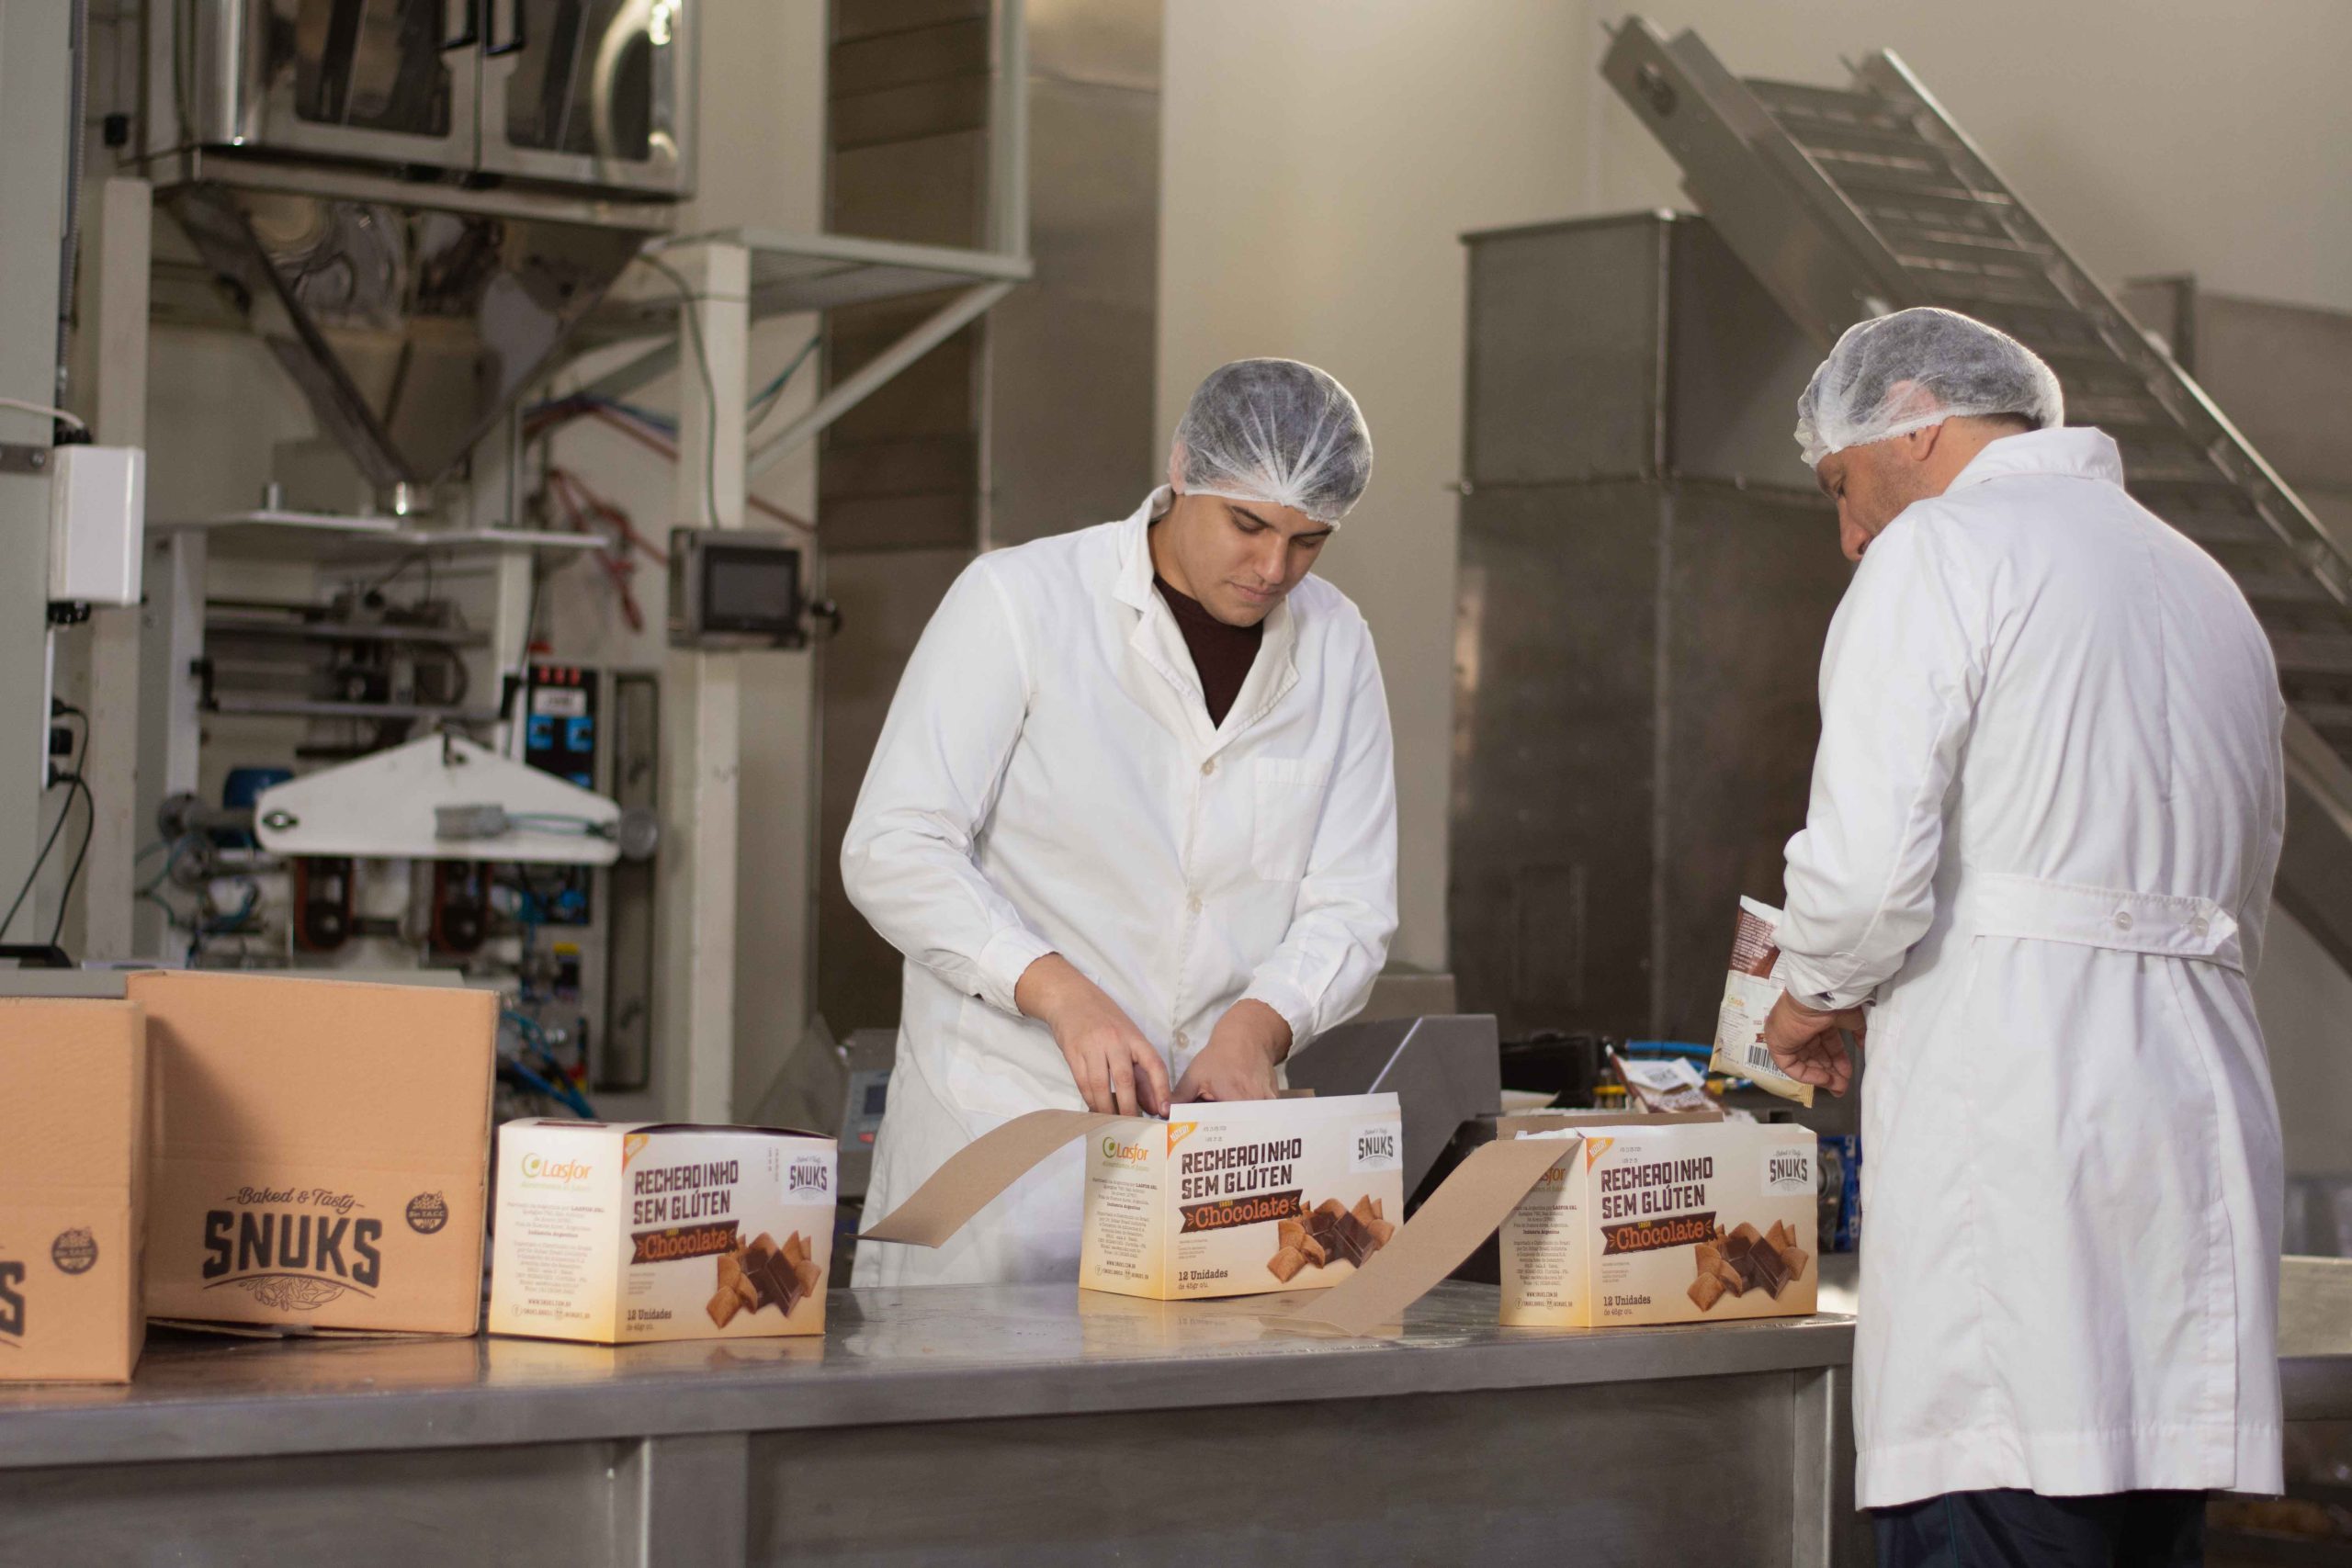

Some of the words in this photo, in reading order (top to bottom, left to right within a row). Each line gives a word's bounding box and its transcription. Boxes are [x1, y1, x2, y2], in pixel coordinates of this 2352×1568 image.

[1116, 1143, 1148, 1164] Lasfor
[1182, 1137, 1302, 1175] RECHEADINHO
[1358, 1135, 1394, 1160] SNUKS
[541, 1158, 593, 1183] Lasfor
[634, 1159, 739, 1195] RECHEADINHO
[789, 1165, 827, 1190] SNUKS
[1182, 1174, 1219, 1200] SEM
[1224, 1164, 1293, 1194] GLÚTEN
[1542, 1168, 1566, 1186] sfor
[1600, 1156, 1713, 1192] RECHEADINHO
[1770, 1158, 1807, 1183] SNUKS
[237, 1187, 293, 1205] Baked
[297, 1191, 310, 1203] &
[312, 1189, 356, 1214] Tasty
[634, 1197, 667, 1224] SEM
[671, 1189, 730, 1221] GLÚTEN
[1195, 1196, 1289, 1228] Chocolate
[1602, 1193, 1637, 1220] SEM
[1641, 1184, 1705, 1213] GLÚTEN
[644, 1227, 728, 1259] Chocolate
[1616, 1218, 1704, 1250] Chocolate
[202, 1210, 383, 1289] SNUKS
[1178, 1270, 1189, 1281] 12
[1191, 1268, 1228, 1280] Unidades
[627, 1309, 637, 1321] 12
[639, 1307, 673, 1321] Unidades
[1603, 1296, 1613, 1306] 12
[1615, 1294, 1651, 1306] Unidades
